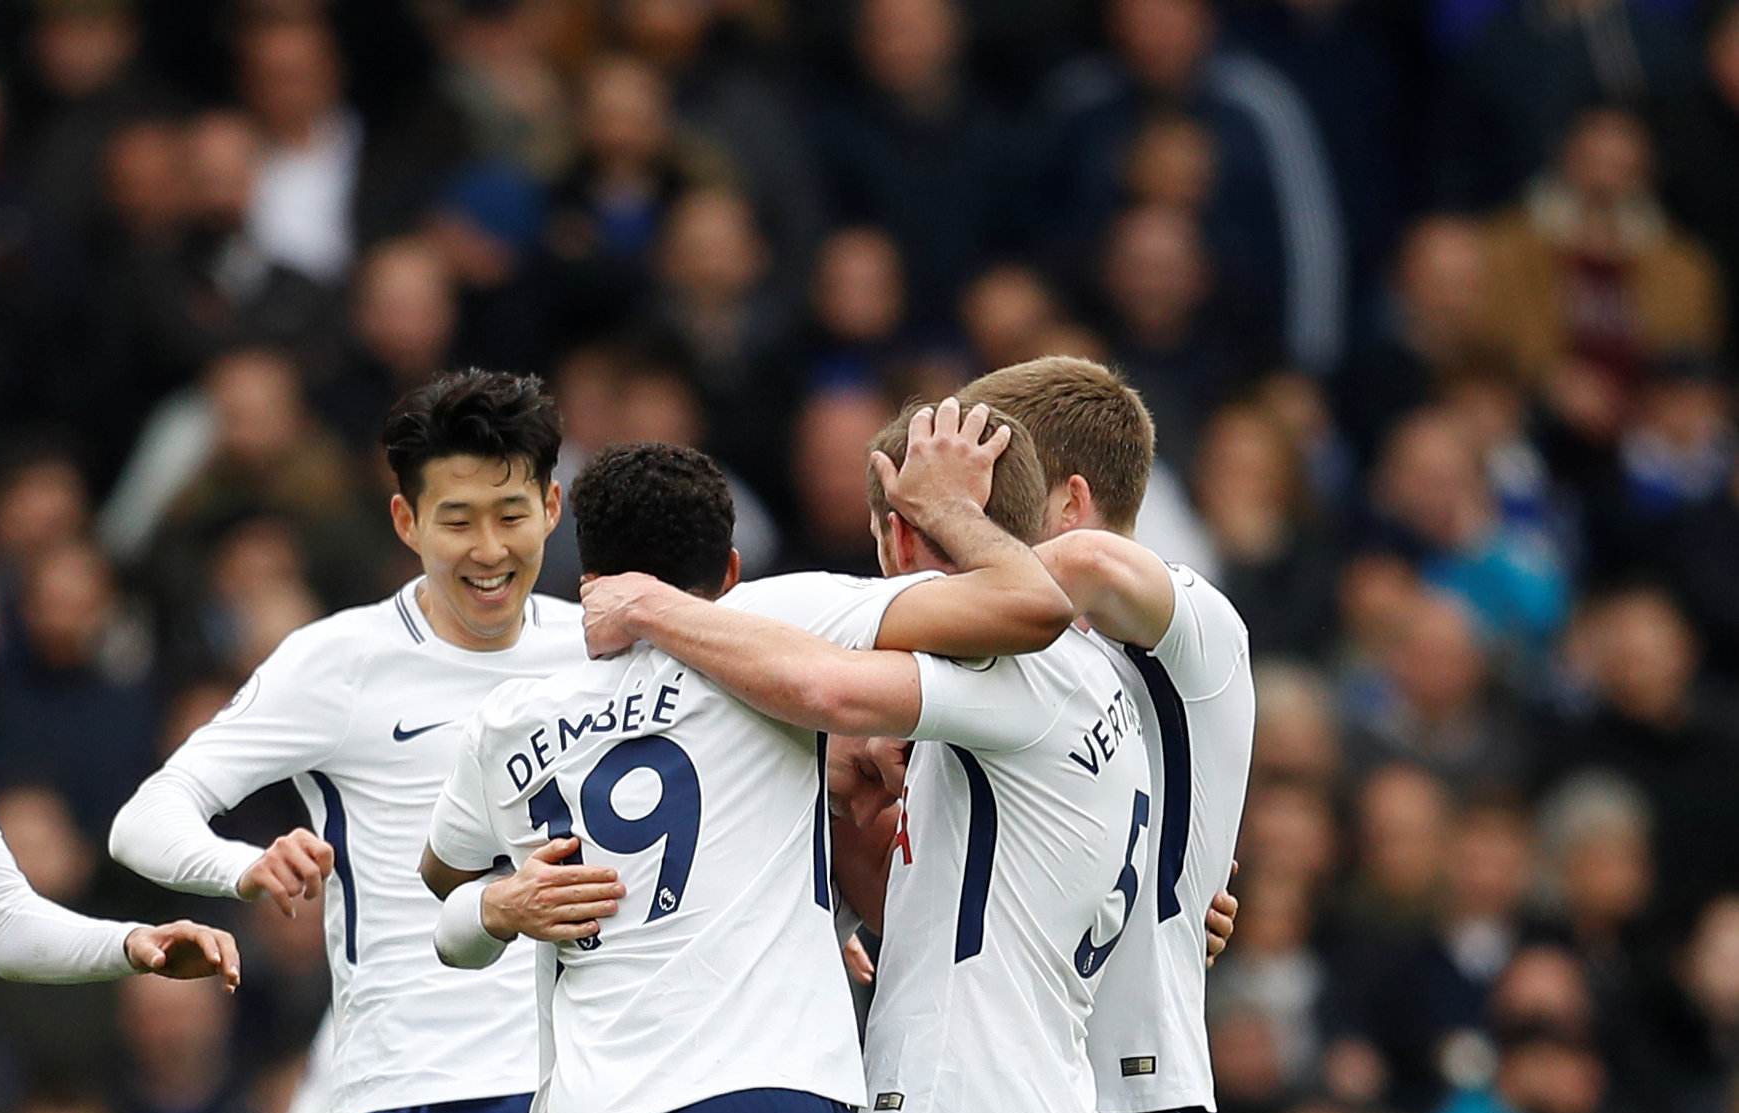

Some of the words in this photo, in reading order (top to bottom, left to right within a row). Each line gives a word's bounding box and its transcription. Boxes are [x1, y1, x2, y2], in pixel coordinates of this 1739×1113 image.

[506, 672, 684, 793] DEMBÉÉ
[1068, 690, 1143, 776] VERT
[527, 734, 702, 950] 19
[1074, 788, 1150, 980] 5
